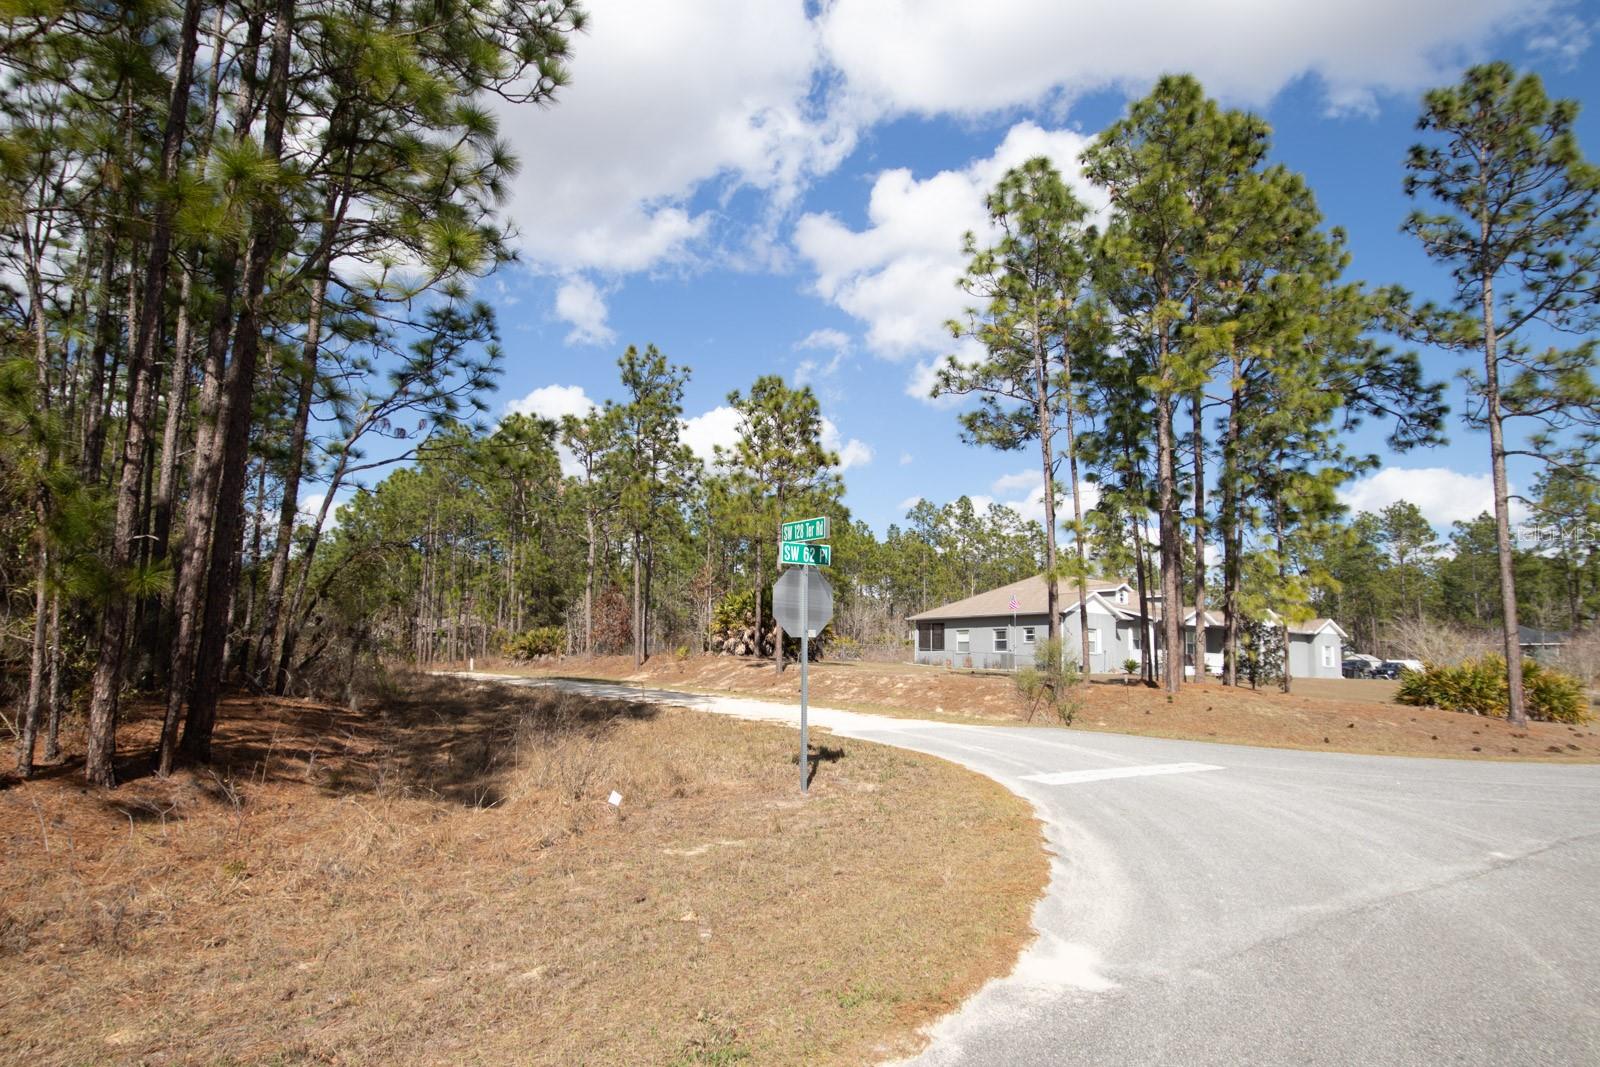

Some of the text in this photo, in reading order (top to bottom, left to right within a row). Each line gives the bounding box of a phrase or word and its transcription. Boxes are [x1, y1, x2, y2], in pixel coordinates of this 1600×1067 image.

[784, 526, 793, 540] SW
[805, 523, 814, 537] Ter
[816, 521, 823, 536] Rd
[784, 545, 800, 561] SW
[803, 547, 815, 562] 62
